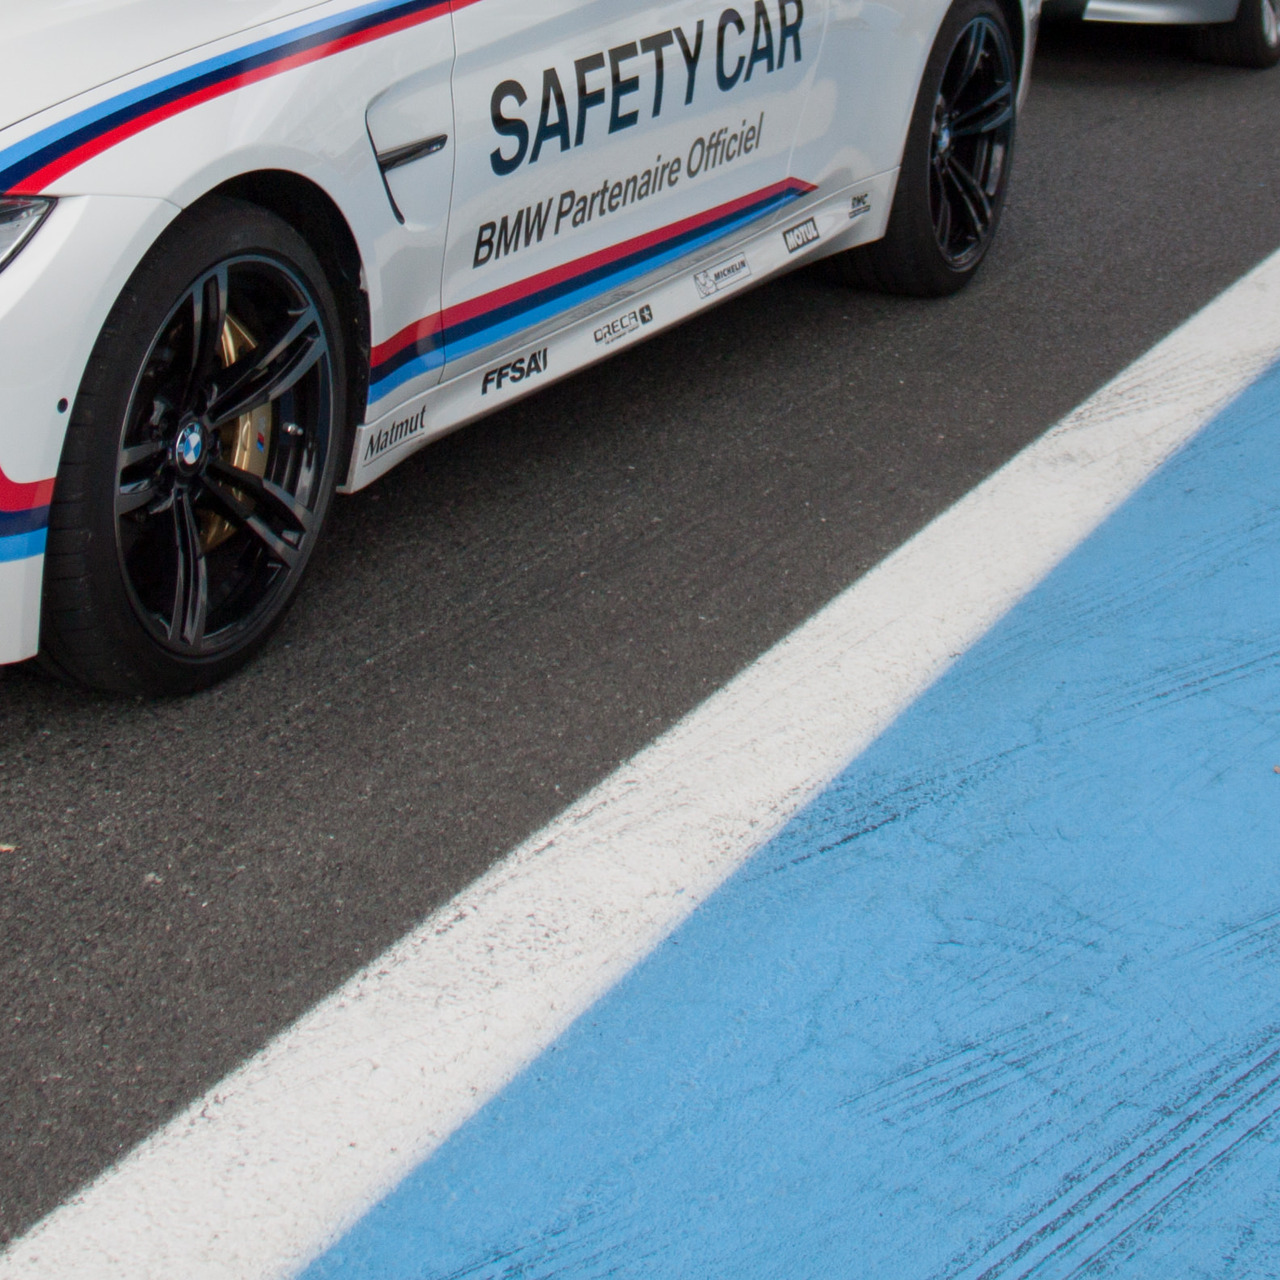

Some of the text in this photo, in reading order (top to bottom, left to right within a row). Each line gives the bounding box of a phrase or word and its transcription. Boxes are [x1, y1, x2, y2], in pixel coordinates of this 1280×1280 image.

[489, 19, 705, 177] SAFETY
[472, 110, 765, 270] BMW Partenaire Officiel
[784, 219, 818, 251] MOTUL
[714, 259, 747, 281] MICHELIN
[593, 310, 639, 343] ORECA
[364, 404, 427, 461] Matmut
